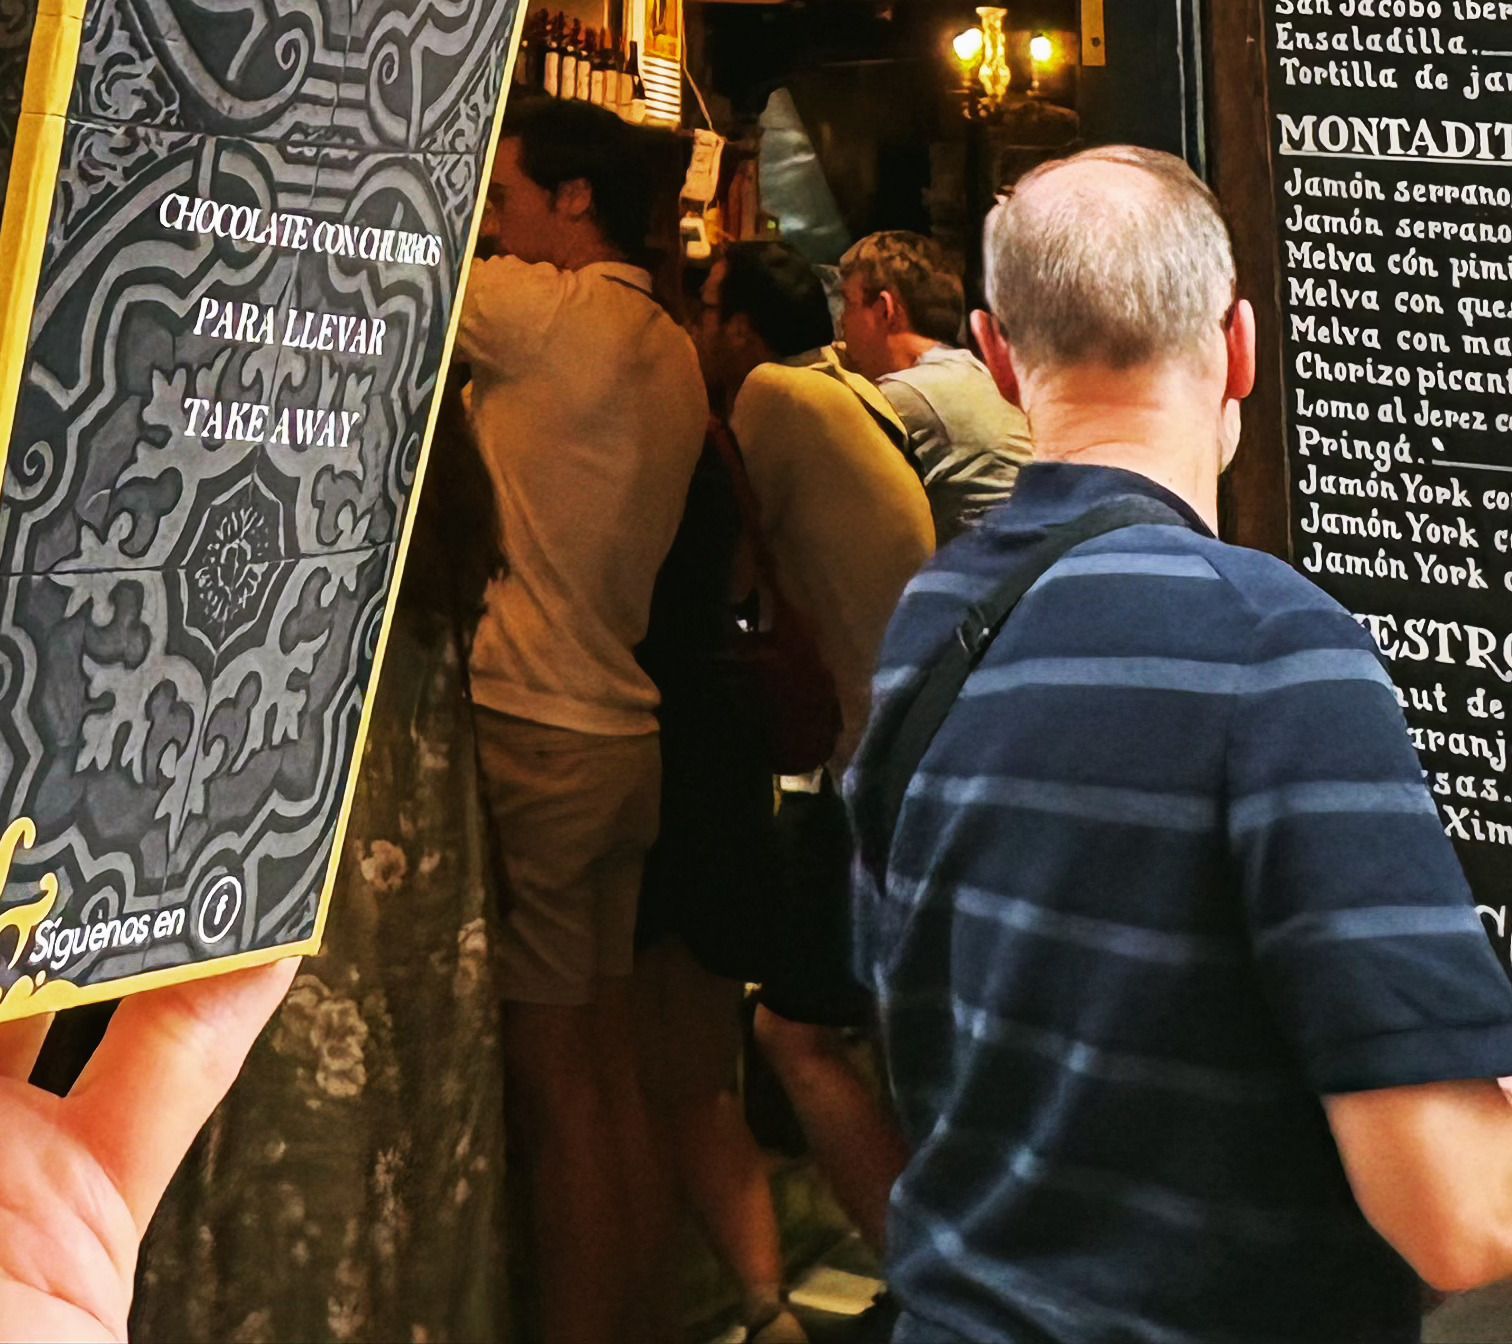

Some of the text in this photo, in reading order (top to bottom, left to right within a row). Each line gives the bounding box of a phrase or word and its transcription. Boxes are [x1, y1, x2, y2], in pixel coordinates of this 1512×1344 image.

[1280, 57, 1399, 89] Tortilla
[1415, 63, 1449, 90] de
[1284, 167, 1386, 201] Jamón
[159, 192, 443, 267] CHOCOLATE CON CHURROS
[1285, 204, 1512, 244] Jamón serrano
[1285, 240, 1376, 273] Melva
[1287, 276, 1380, 312] Melva
[1394, 291, 1444, 314] con
[193, 297, 387, 356] PARA LLEVAR
[1289, 313, 1382, 350] Melva
[1396, 330, 1451, 354] con
[1295, 351, 1411, 387] Chorizo
[183, 397, 361, 448] TAKE AWAY
[1295, 388, 1370, 420] Lomo
[1377, 396, 1407, 424] al
[1413, 399, 1488, 431] Jerez
[1298, 464, 1399, 501] Jamón
[1399, 472, 1472, 508] York
[1300, 501, 1403, 540] Jamón
[1405, 511, 1480, 549] York
[1302, 542, 1409, 580] Jamón
[1413, 551, 1489, 590] York
[1466, 687, 1506, 720] de
[153, 907, 186, 936] en
